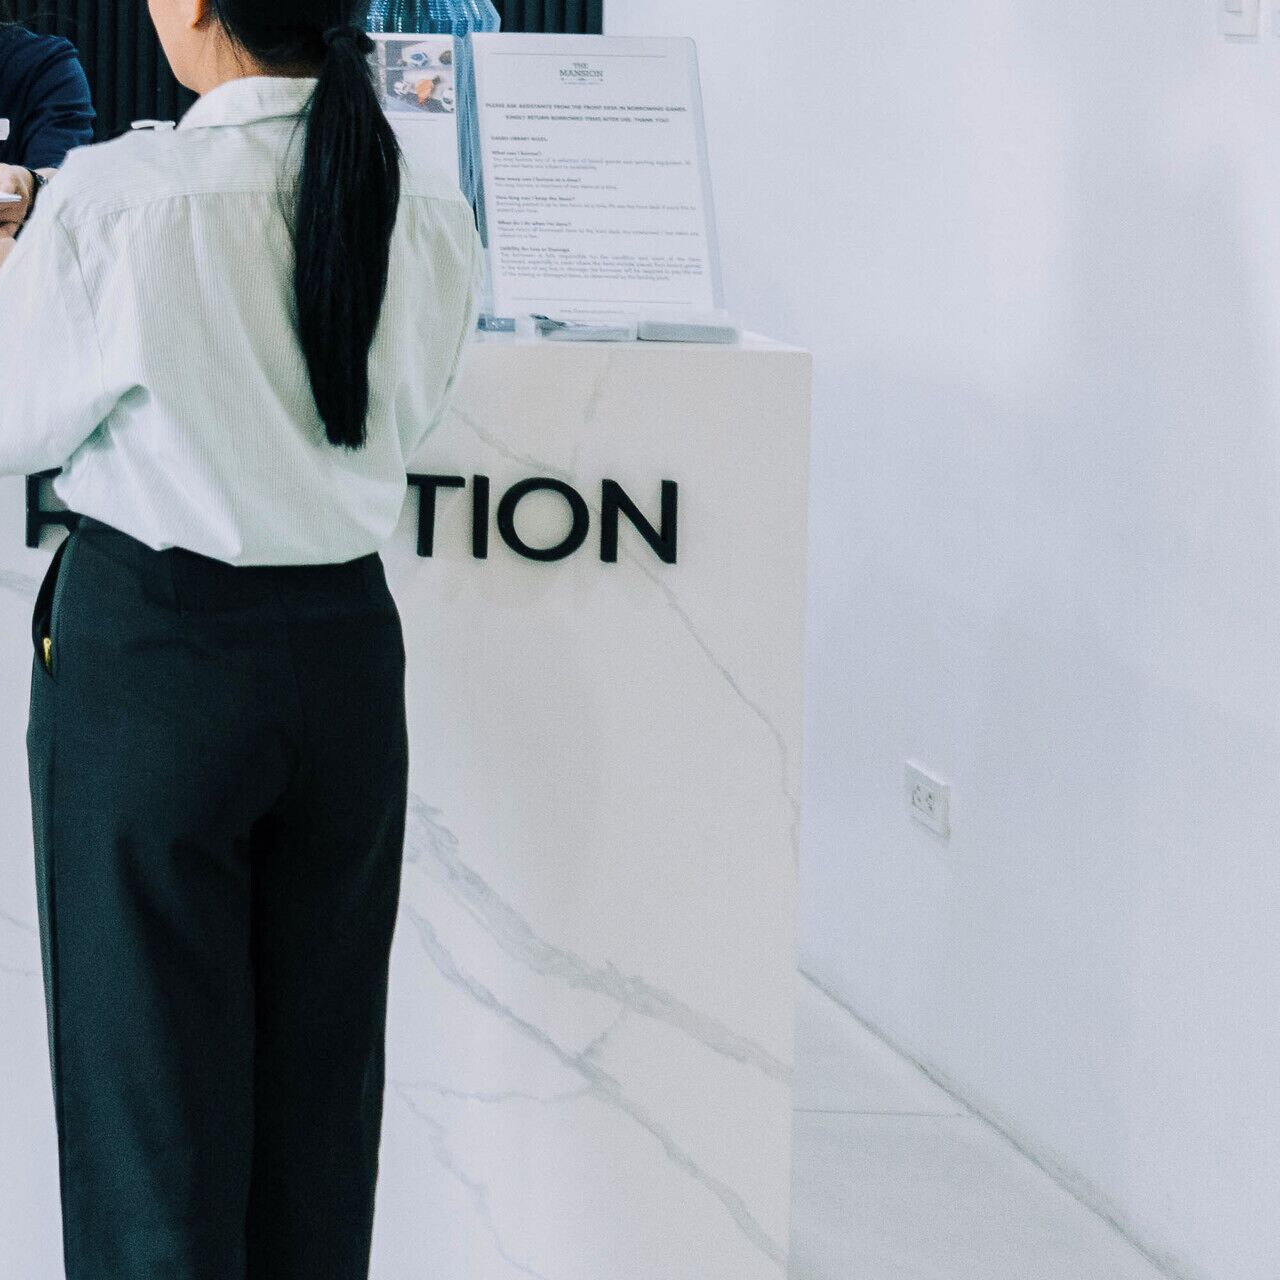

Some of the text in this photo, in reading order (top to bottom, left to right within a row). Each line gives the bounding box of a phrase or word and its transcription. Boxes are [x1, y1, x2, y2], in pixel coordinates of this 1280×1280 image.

[572, 62, 589, 70] THE
[559, 69, 604, 78] MANSION
[25, 466, 678, 564] RTION
